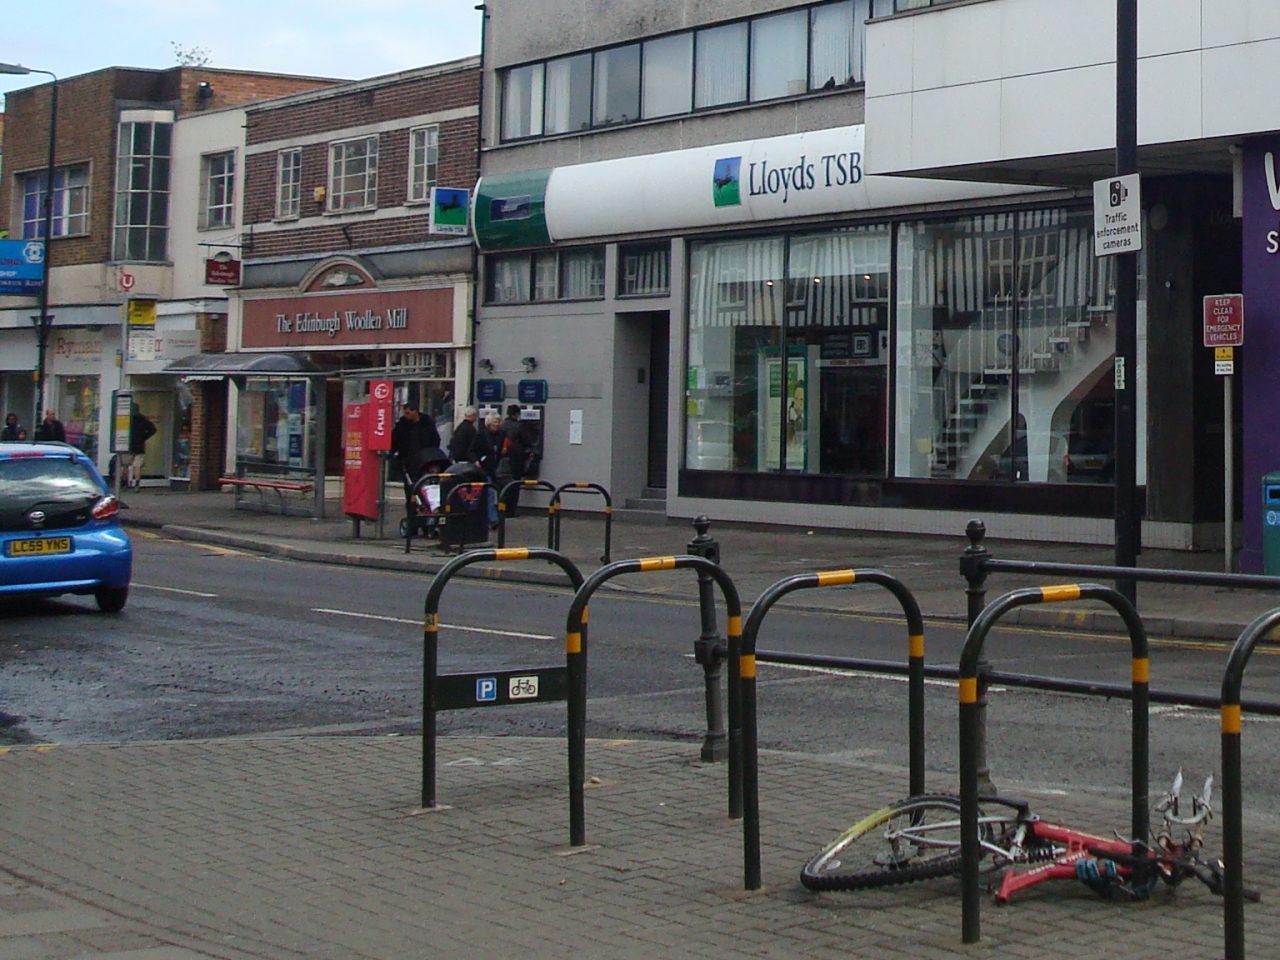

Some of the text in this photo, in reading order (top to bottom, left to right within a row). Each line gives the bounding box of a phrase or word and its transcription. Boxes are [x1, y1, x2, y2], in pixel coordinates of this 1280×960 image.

[749, 152, 862, 204] Lloyds TSB
[1105, 212, 1128, 224] Traffic
[1097, 222, 1139, 238] enforcement
[1103, 238, 1131, 249] cameras
[1213, 307, 1233, 315] CLEAR
[276, 307, 407, 337] The Edinburgh Woollen Mill
[1207, 324, 1240, 333] EMERGENCY
[1210, 333, 1237, 341] VEHICLES
[481, 681, 493, 698] P
